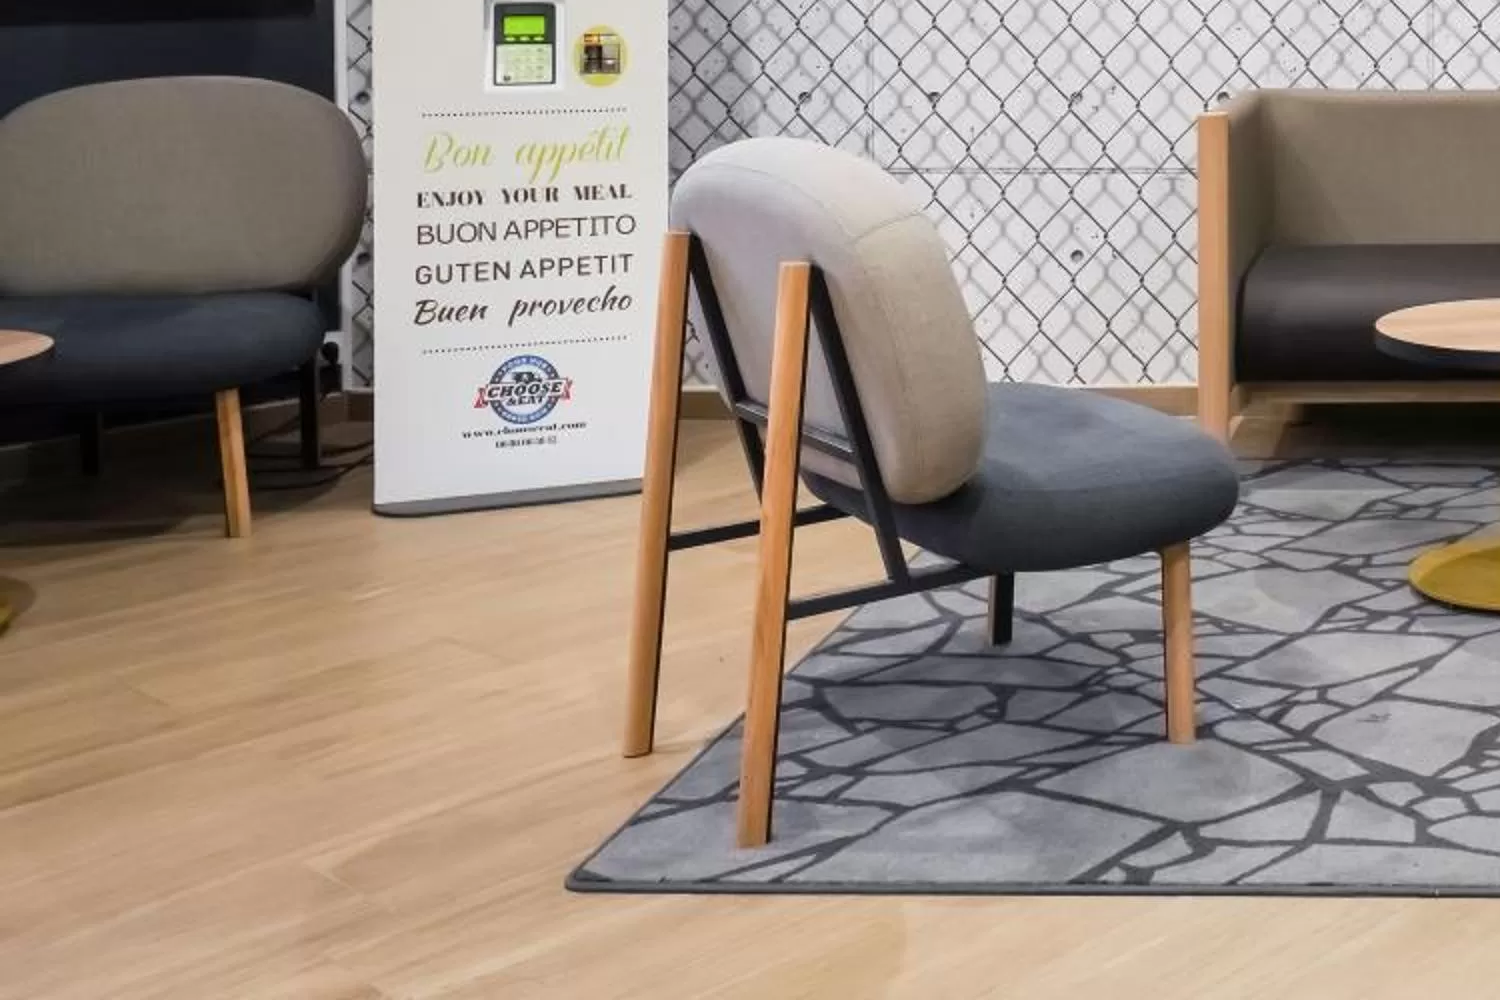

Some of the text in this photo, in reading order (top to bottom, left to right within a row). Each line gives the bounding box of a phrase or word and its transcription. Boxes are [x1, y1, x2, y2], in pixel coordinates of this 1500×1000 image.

[423, 121, 631, 184] Bon appétit
[416, 183, 633, 209] ENJOY YOUR MEAL
[416, 213, 637, 246] BUON APPETITO
[415, 253, 634, 285] GUTEN APPETIT
[413, 284, 633, 328] Buen provecho
[487, 381, 564, 399] CHOOSE
